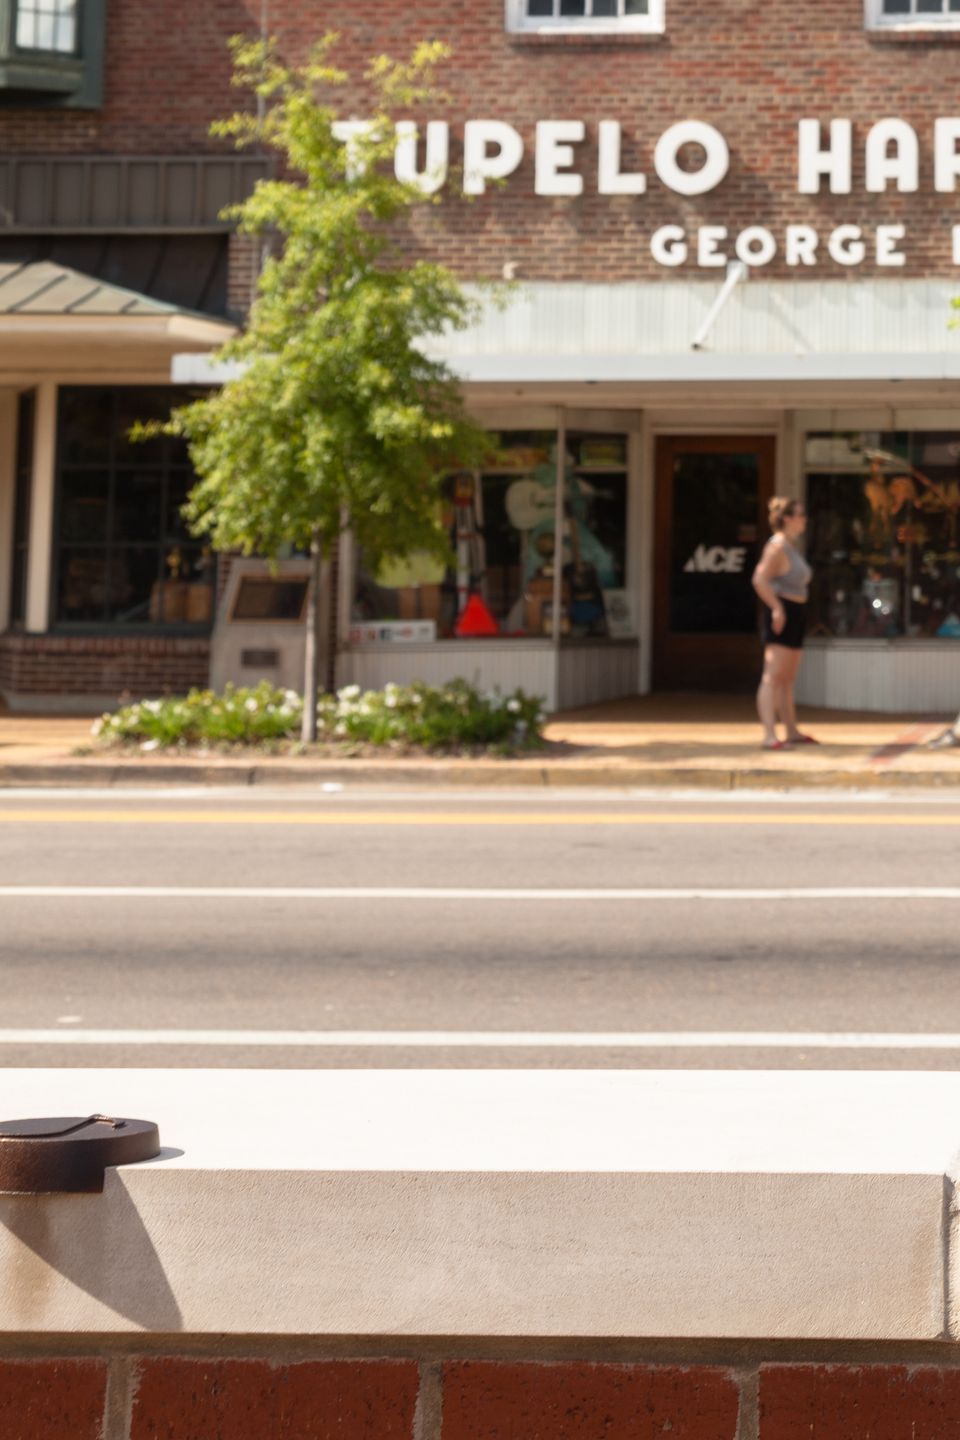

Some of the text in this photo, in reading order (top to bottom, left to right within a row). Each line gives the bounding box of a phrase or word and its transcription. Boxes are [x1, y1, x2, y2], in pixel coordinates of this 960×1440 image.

[330, 120, 730, 196] TUPELO
[650, 224, 906, 267] GEORGE
[683, 544, 747, 573] ACE
